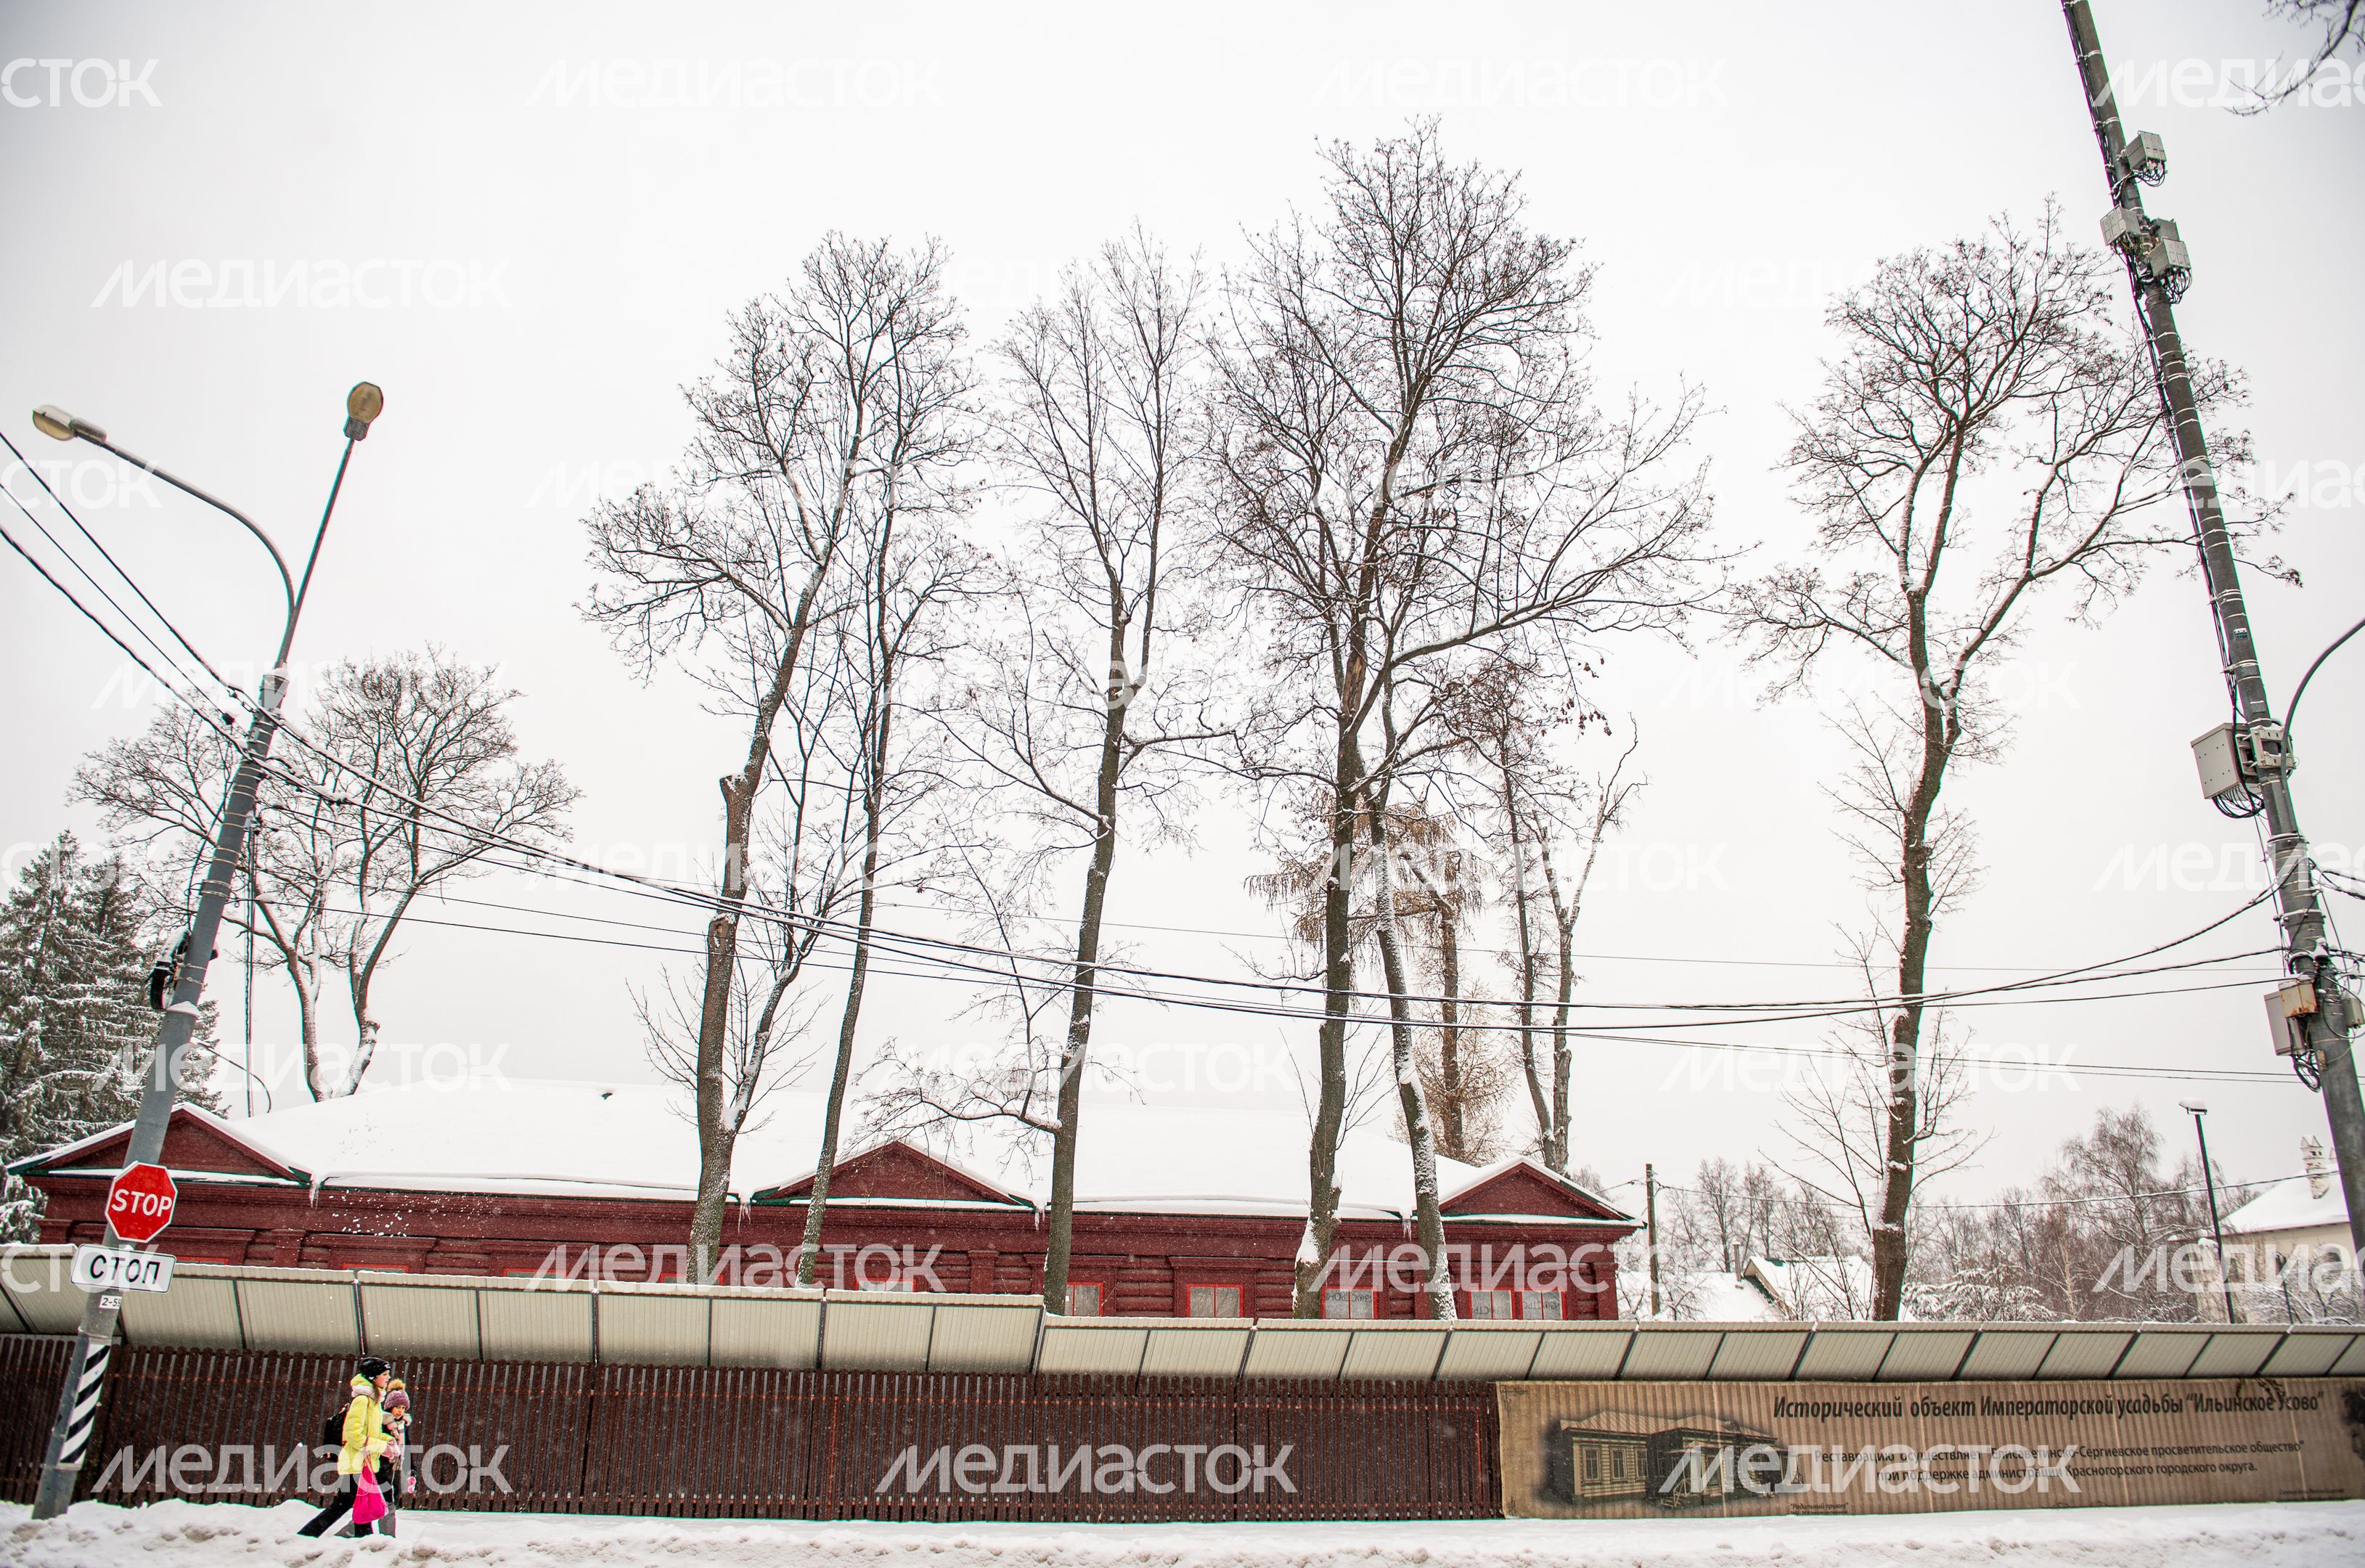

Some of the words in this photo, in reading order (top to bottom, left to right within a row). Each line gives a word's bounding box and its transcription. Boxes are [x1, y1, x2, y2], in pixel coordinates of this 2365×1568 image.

[111, 1189, 172, 1217] STOP
[90, 1254, 160, 1285] СТОП
[1773, 1396, 1903, 1423] Исторический
[1909, 1396, 1976, 1418] объект
[1980, 1395, 2113, 1421] Императорской
[2117, 1393, 2184, 1419] усадьбы
[1815, 1450, 1895, 1463] Реставрацию
[2151, 1444, 2248, 1459] просветительское
[1877, 1471, 1900, 1482] при
[1903, 1469, 1969, 1483] поддержке
[1972, 1467, 2062, 1482] администрации
[2065, 1463, 2154, 1478] Красногорского
[2156, 1462, 2217, 1476] городского
[2219, 1461, 2258, 1474] округа.
